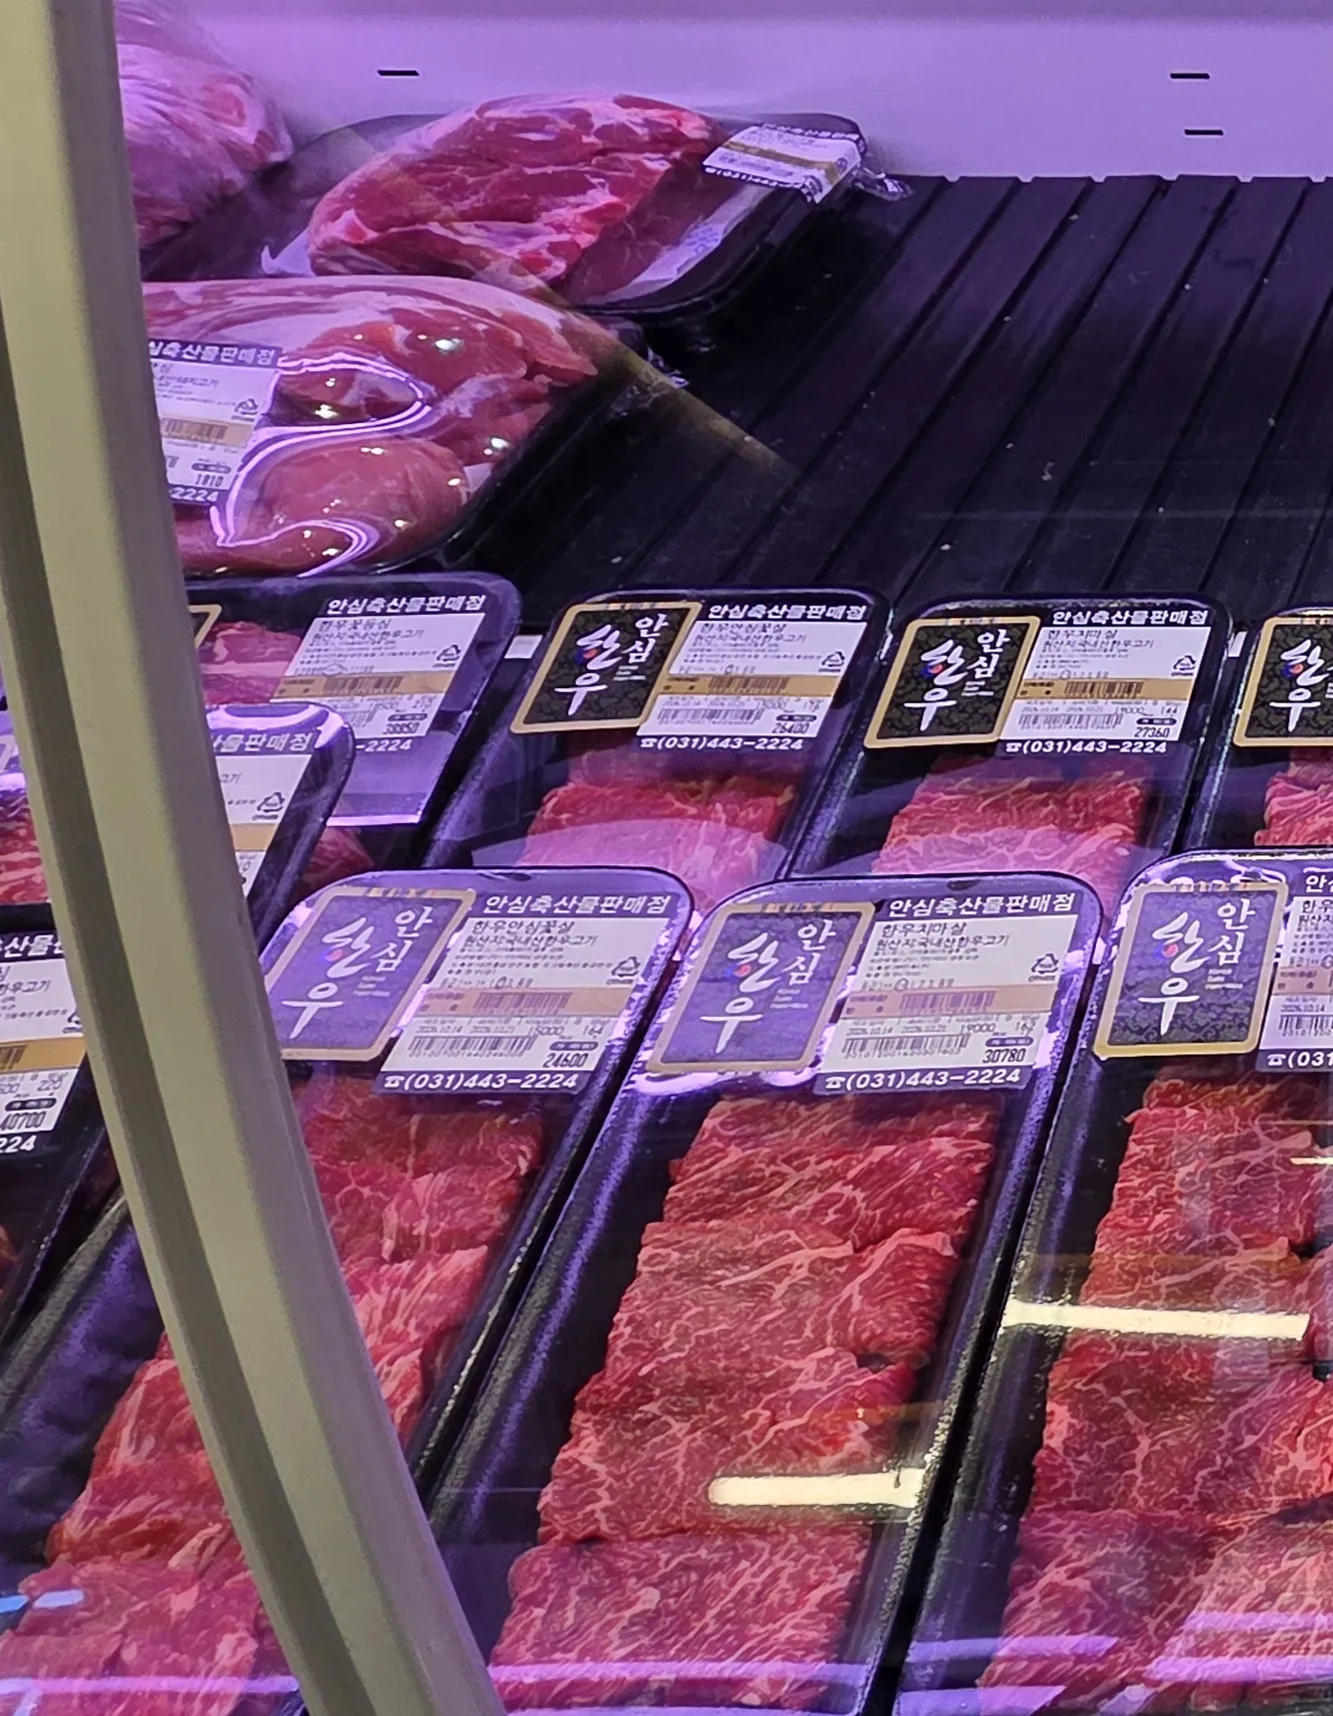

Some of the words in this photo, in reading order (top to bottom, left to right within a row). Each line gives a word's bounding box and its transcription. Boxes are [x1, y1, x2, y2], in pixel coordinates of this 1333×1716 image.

[149, 340, 275, 365] 심축산물판매점
[555, 624, 623, 716] 한우
[904, 639, 967, 731] 한우
[1269, 639, 1331, 731] 한우
[657, 736, 804, 751] (031)443-2224
[1134, 726, 1171, 739] 27360
[1023, 740, 1167, 754] (031)443-2224
[482, 894, 672, 916] 안심축산물판매점
[888, 892, 1076, 919] 안심축산물판매점
[281, 917, 374, 1039] 한우
[1138, 911, 1211, 1036] 한우
[700, 932, 784, 1055] 한우
[542, 1051, 589, 1068] 24600
[982, 1048, 1026, 1064] 30780
[404, 1072, 579, 1090] (031)443-2224
[846, 1067, 1021, 1091] (031)443-2224
